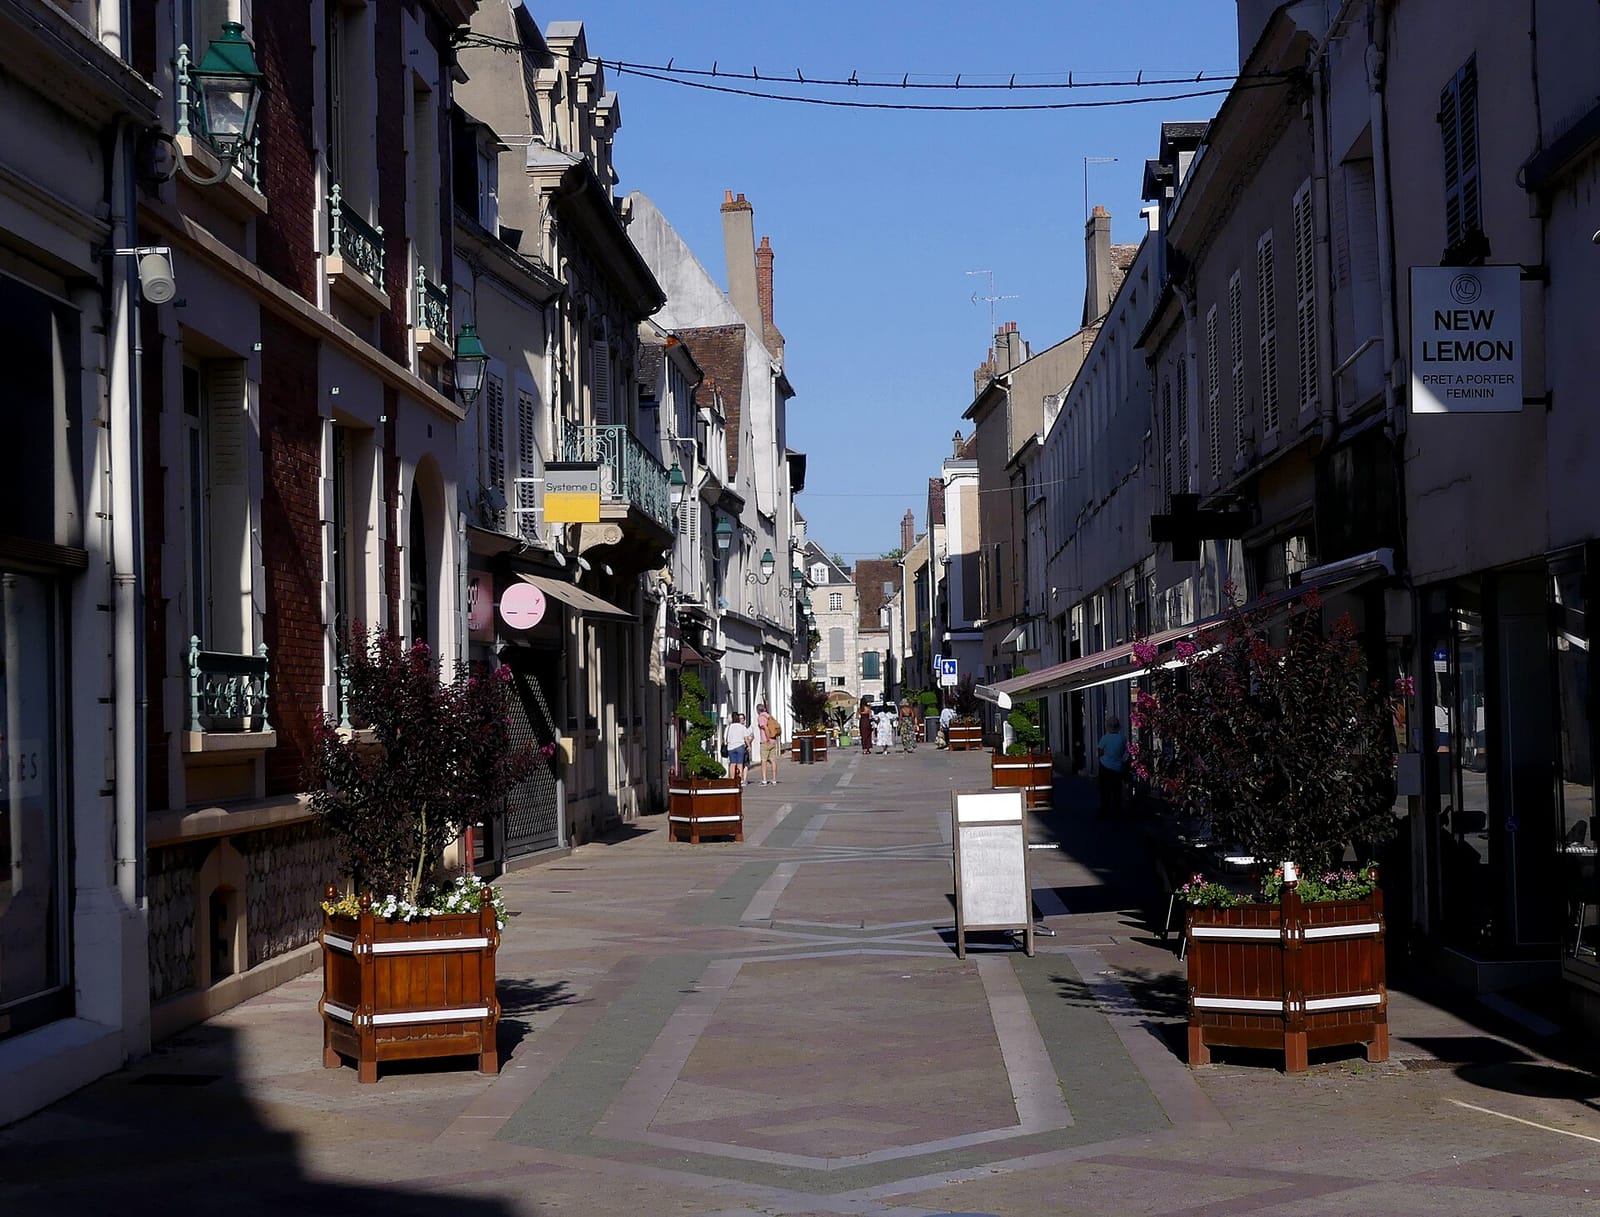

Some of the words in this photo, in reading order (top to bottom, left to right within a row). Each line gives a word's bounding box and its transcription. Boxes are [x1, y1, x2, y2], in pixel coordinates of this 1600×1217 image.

[1434, 309, 1495, 331] NEW
[1422, 340, 1513, 362] LEMON
[1422, 374, 1454, 385] PRET
[1455, 374, 1464, 385] A
[1466, 374, 1515, 385] PORTER
[1446, 388, 1494, 399] FEMININ
[545, 482, 588, 493] Systeme
[590, 482, 598, 492] D
